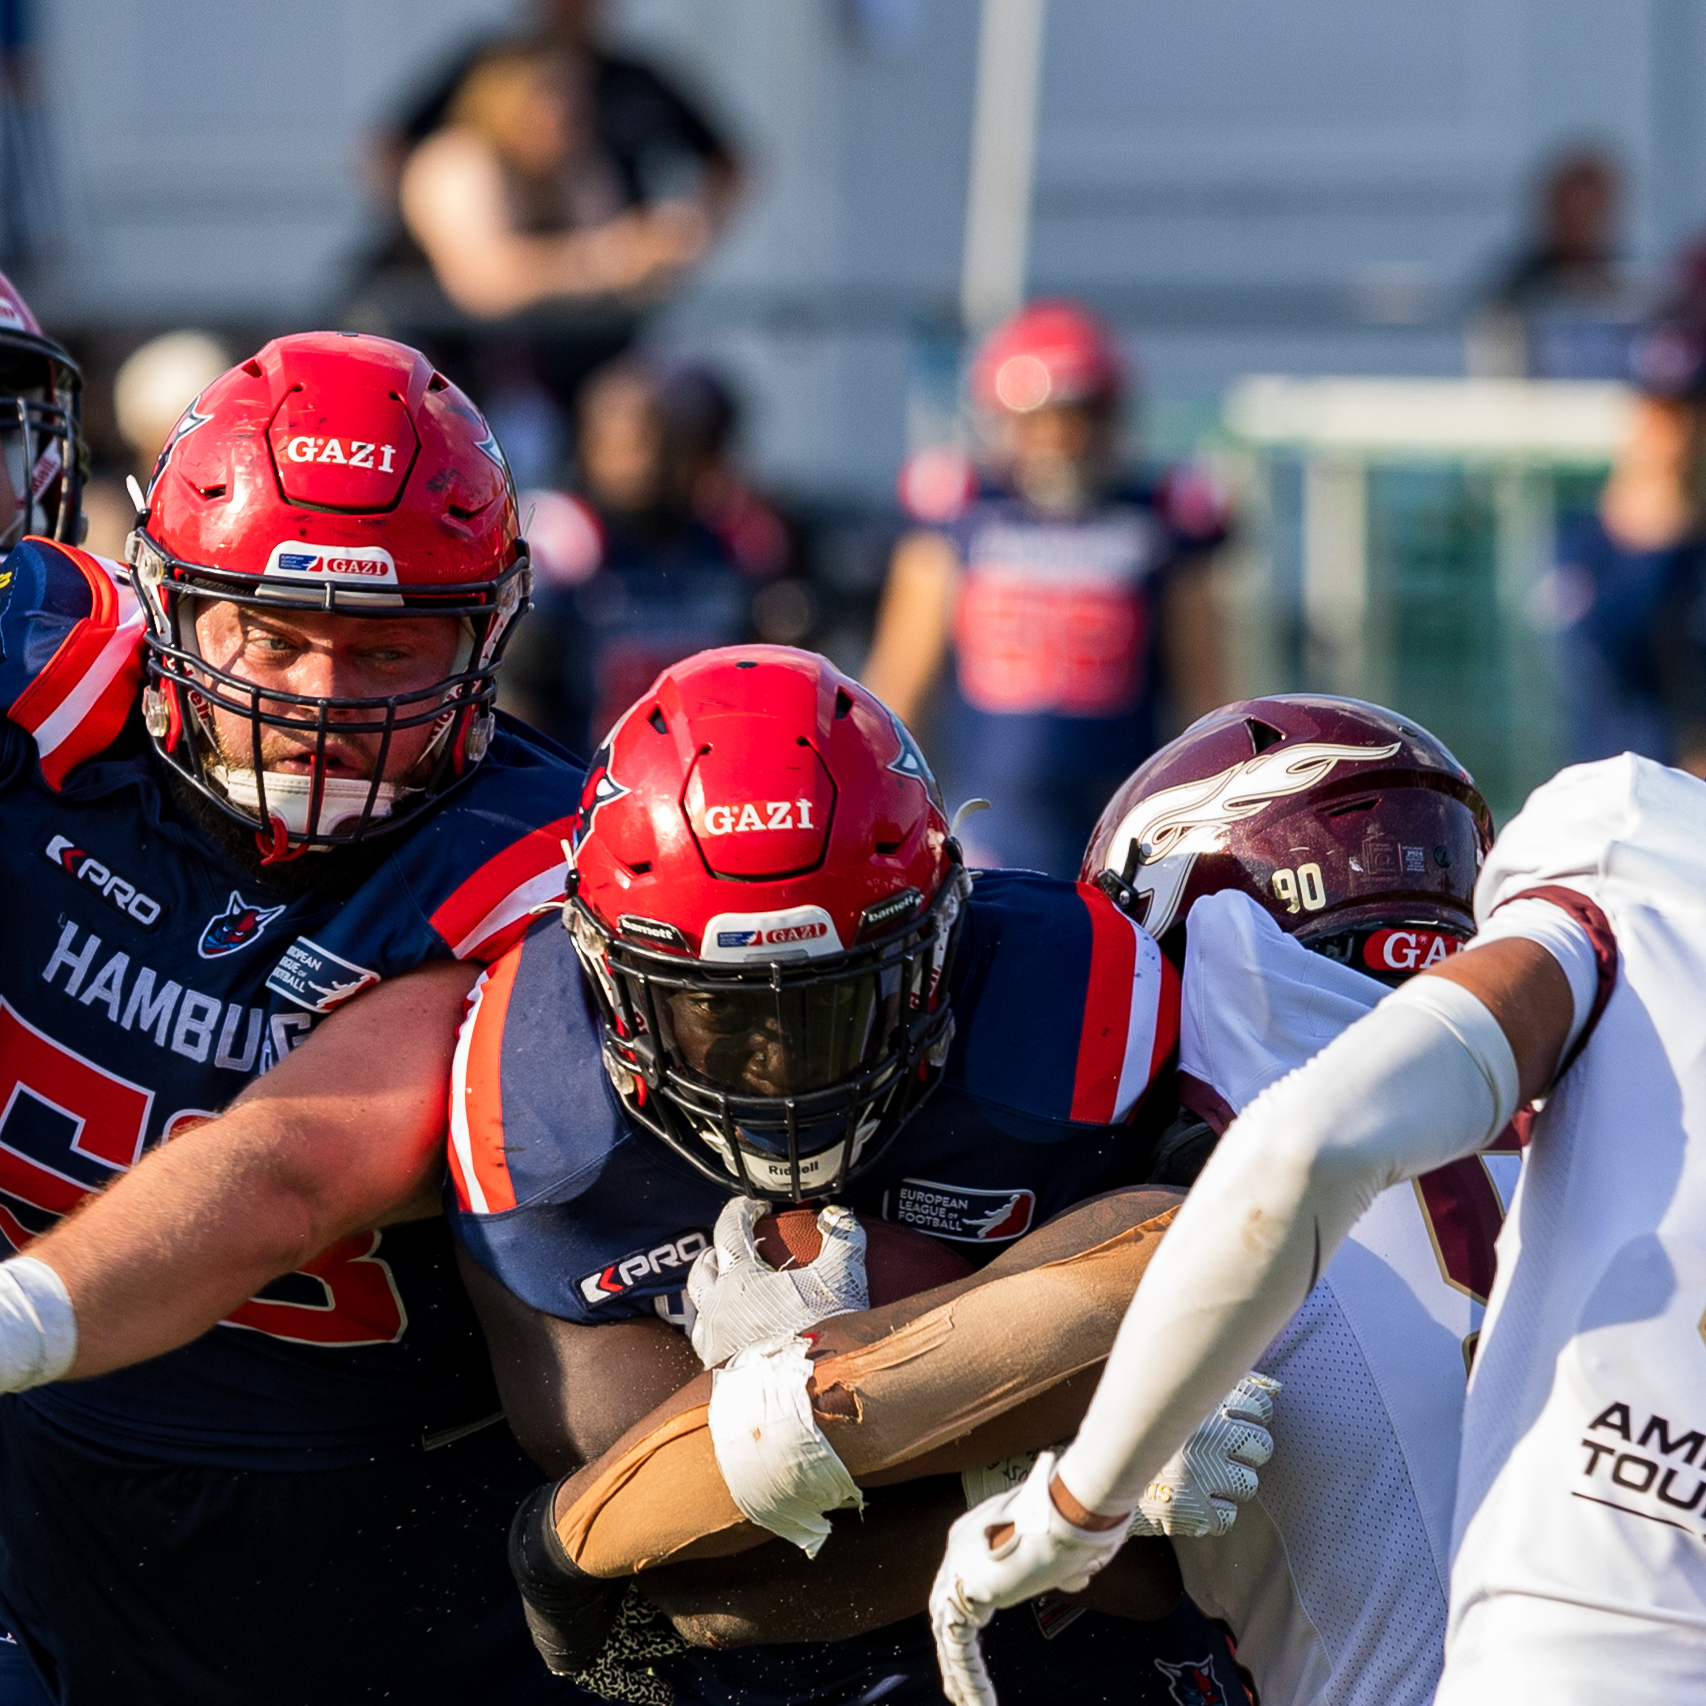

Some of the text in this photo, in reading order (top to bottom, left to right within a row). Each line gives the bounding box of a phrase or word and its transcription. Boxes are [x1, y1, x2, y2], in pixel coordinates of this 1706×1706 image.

[1271, 862, 1327, 914] 90
[1382, 931, 1465, 969] GA
[41, 917, 312, 1076] HAMBUG
[768, 1161, 819, 1176] Ridell
[898, 1199, 946, 1218] LEAGUE
[899, 1188, 969, 1210] EUROPEAN
[897, 1210, 963, 1231] FOOTBALL
